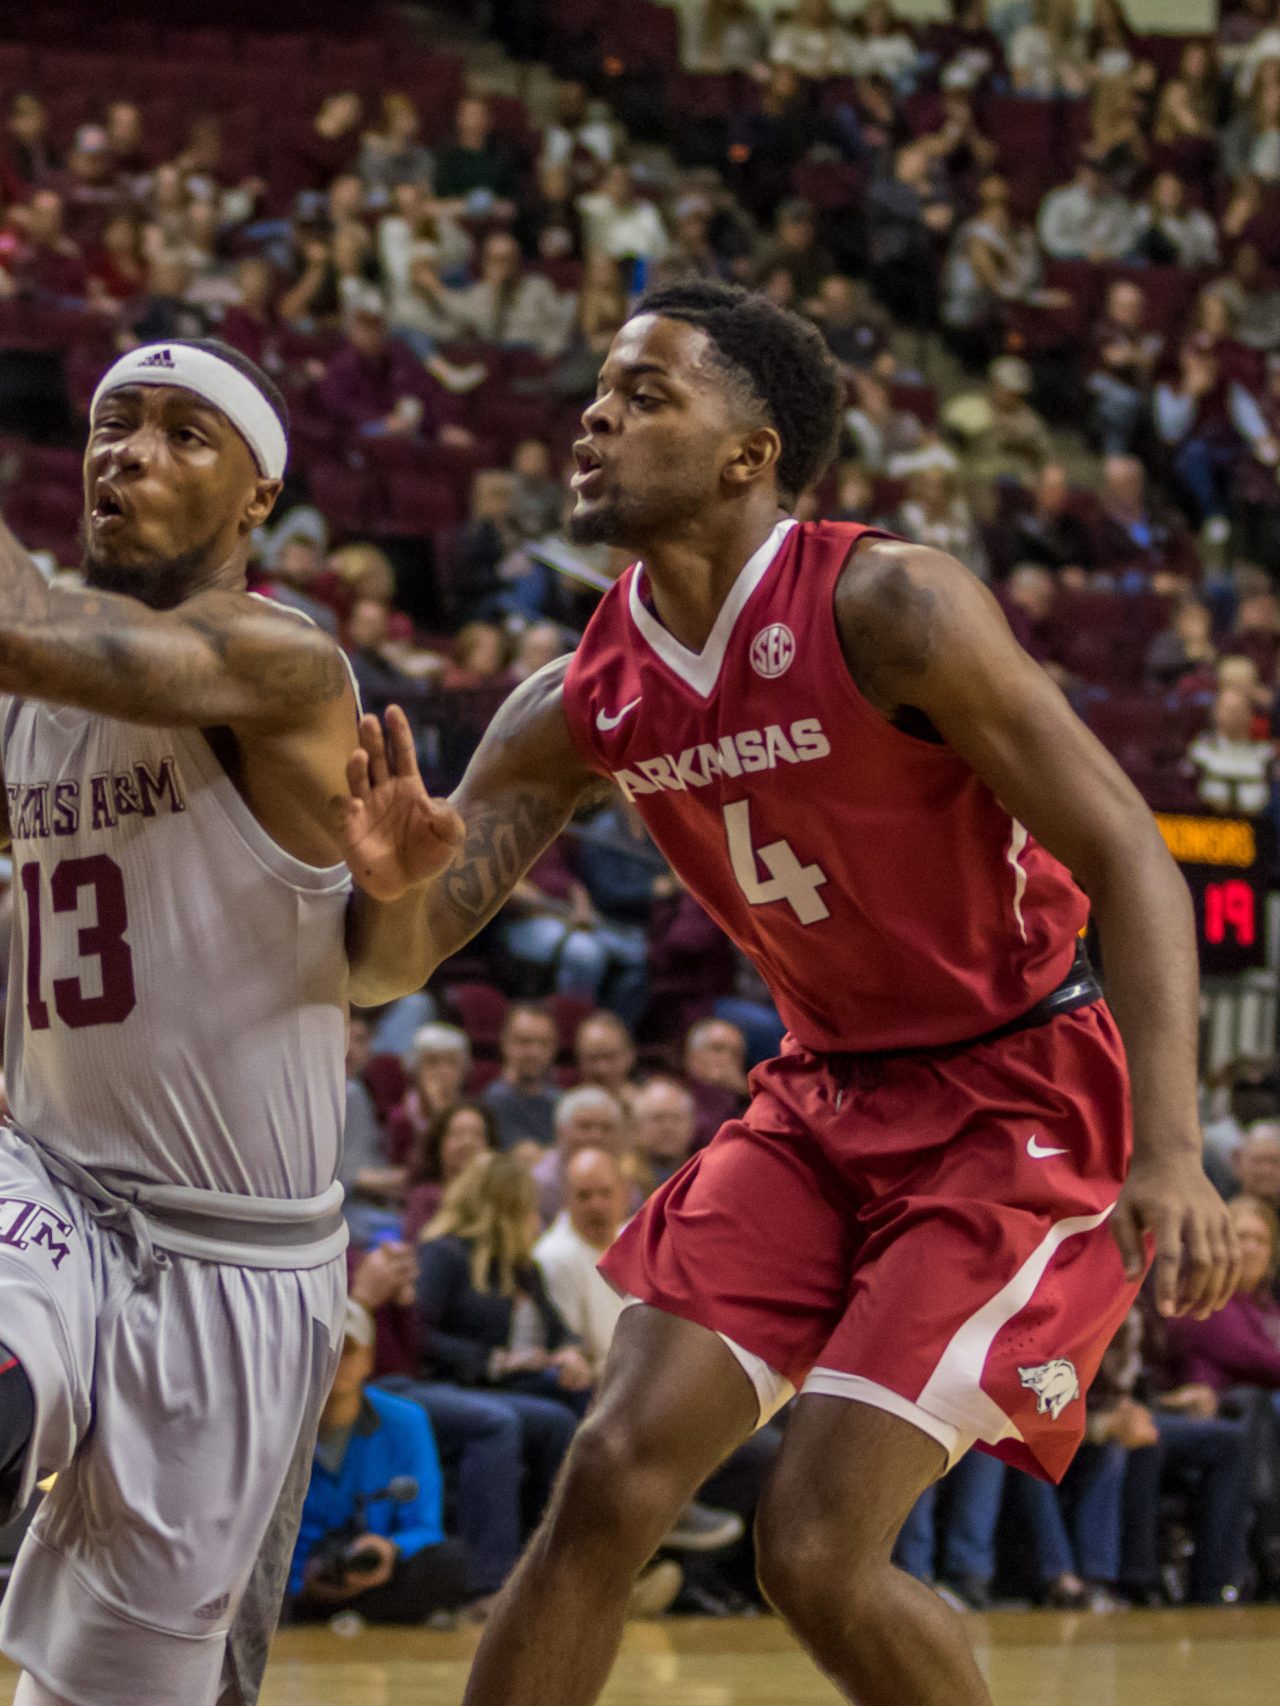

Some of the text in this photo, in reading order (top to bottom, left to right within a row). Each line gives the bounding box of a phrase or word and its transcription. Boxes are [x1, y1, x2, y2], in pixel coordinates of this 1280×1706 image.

[751, 625, 794, 676] SEC
[90, 755, 186, 831] A&M
[612, 717, 832, 803] ARKANSAS
[722, 799, 831, 926] 4
[21, 853, 137, 1031] 13
